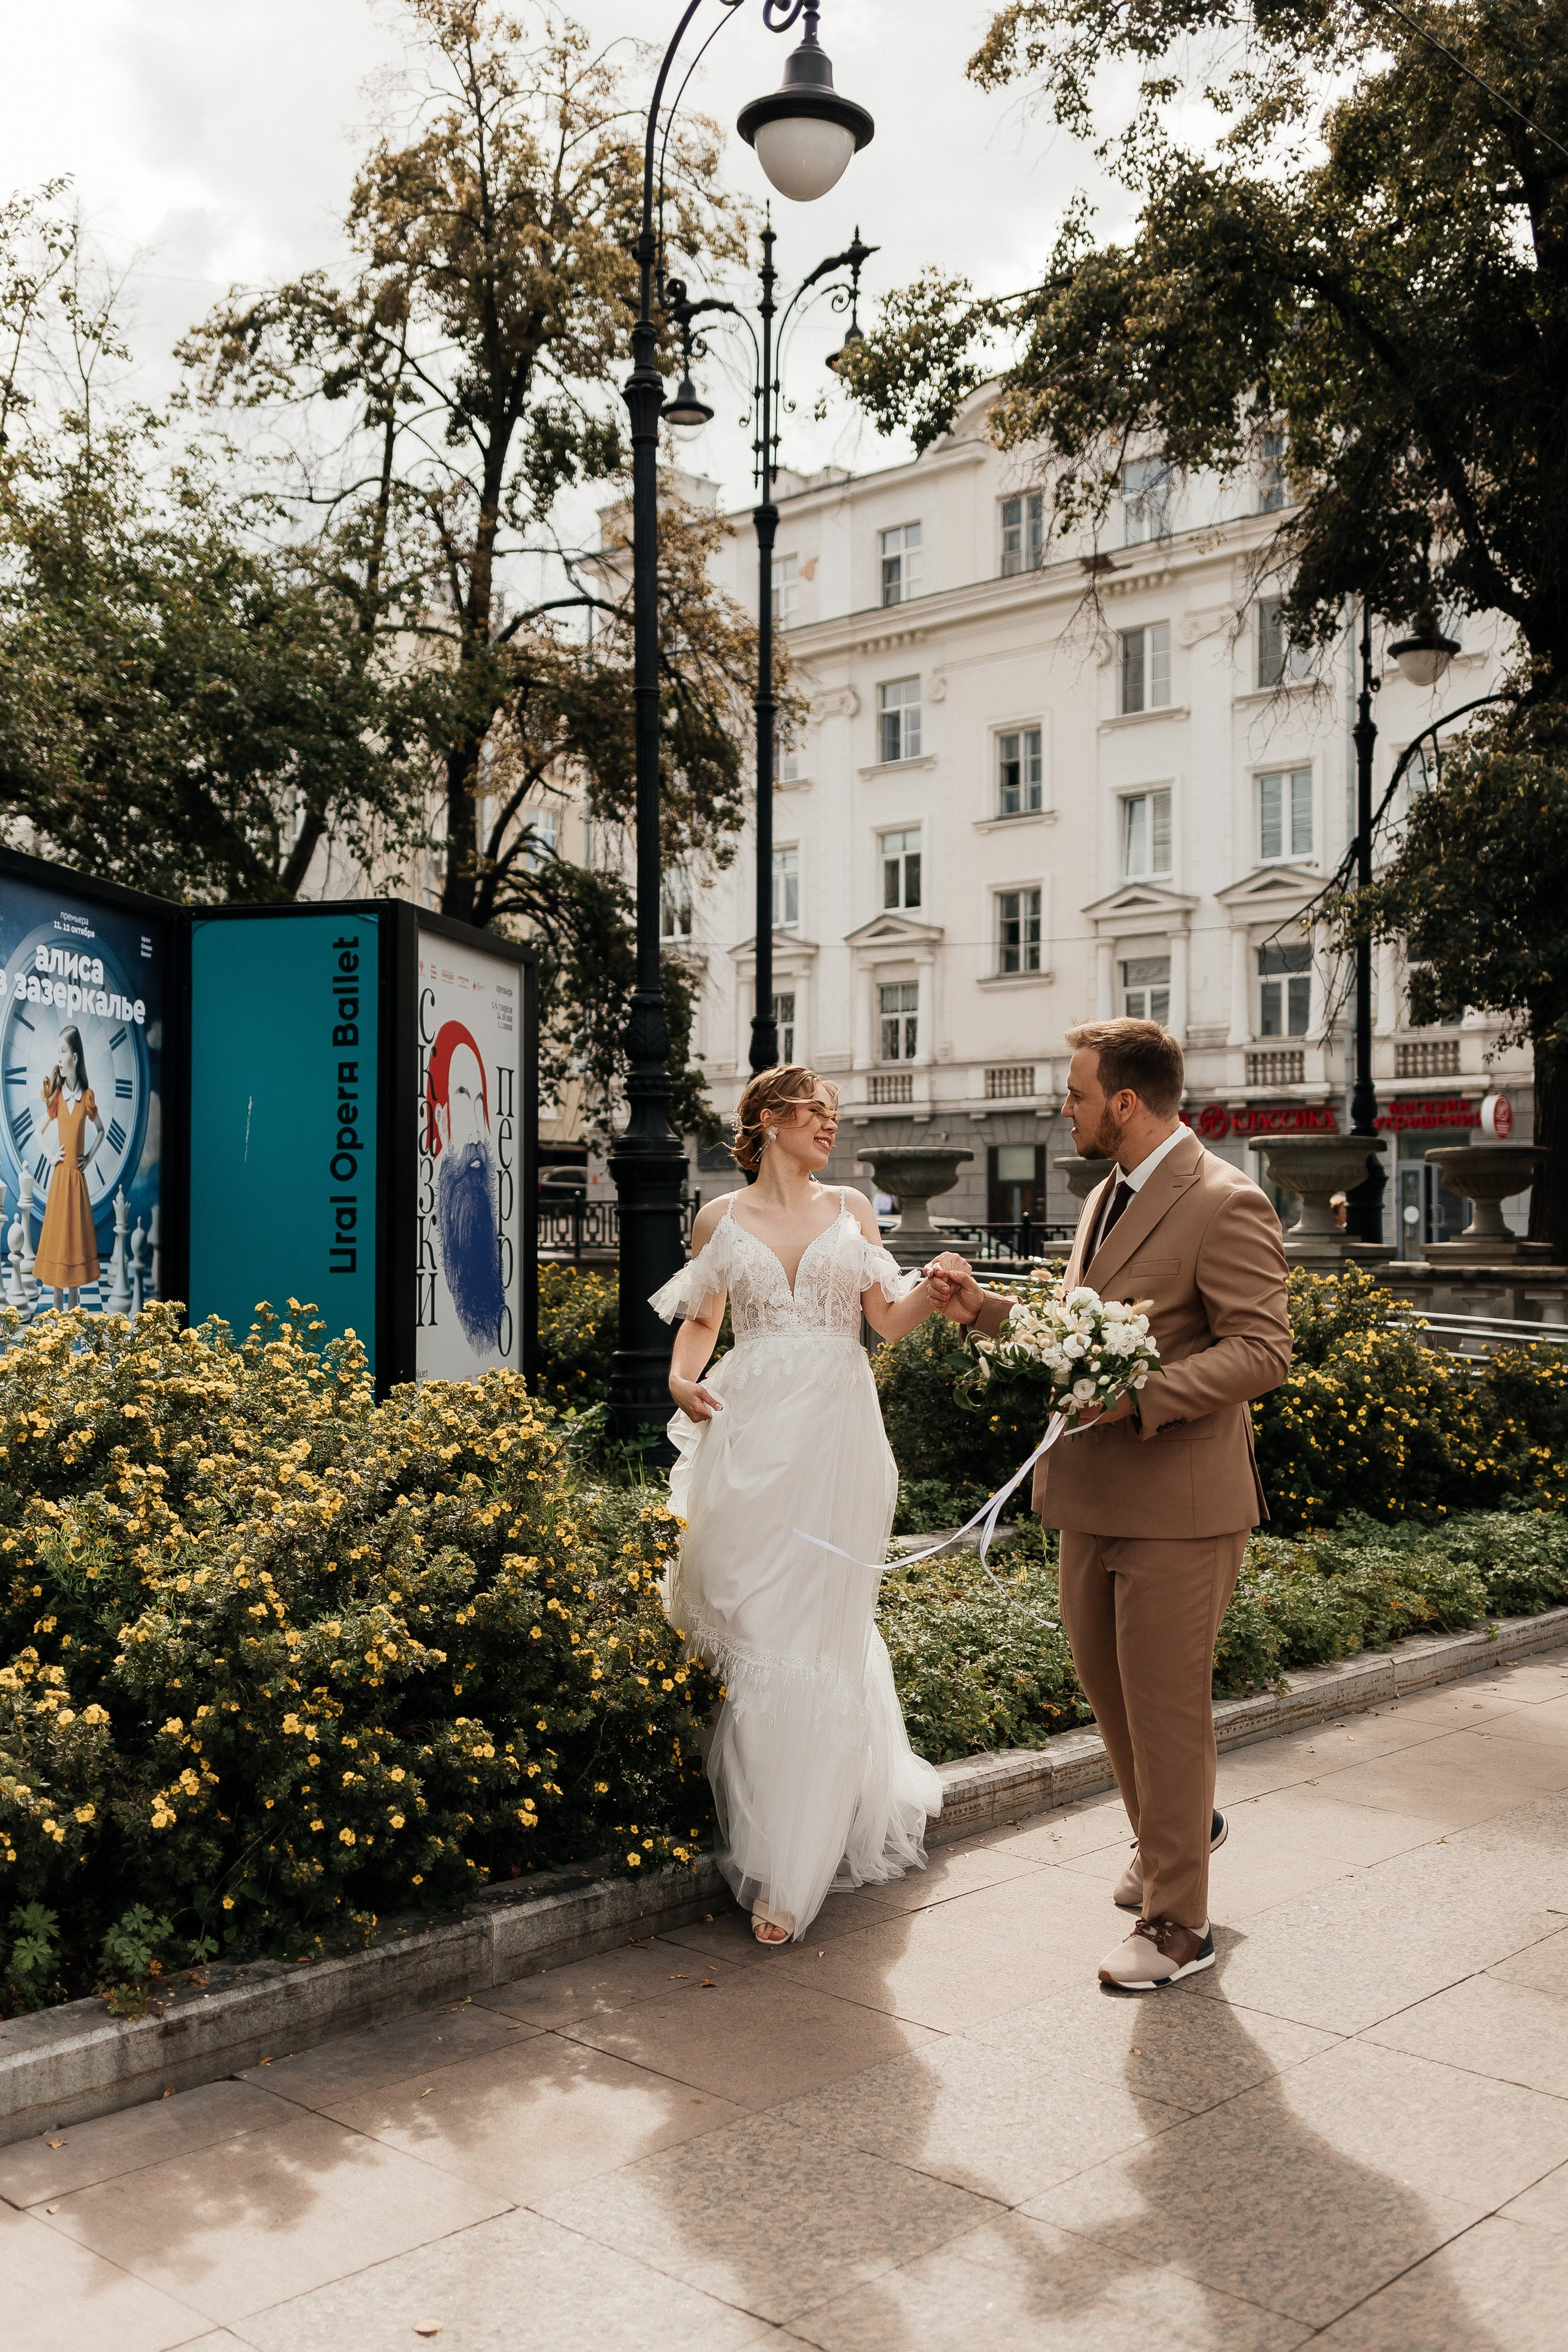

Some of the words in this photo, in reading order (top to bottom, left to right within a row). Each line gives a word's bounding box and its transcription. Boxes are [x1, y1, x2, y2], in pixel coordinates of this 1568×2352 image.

[60, 911, 89, 927] премьера
[63, 923, 70, 932] 12
[70, 926, 95, 940] октября
[35, 944, 104, 985] алиса
[13, 971, 146, 1024] зазеркалье
[333, 936, 359, 1046] Ballet
[1232, 1111, 1335, 1129] КЛАССИКА
[1388, 1099, 1470, 1114] магазин
[329, 1196, 357, 1273] Ural
